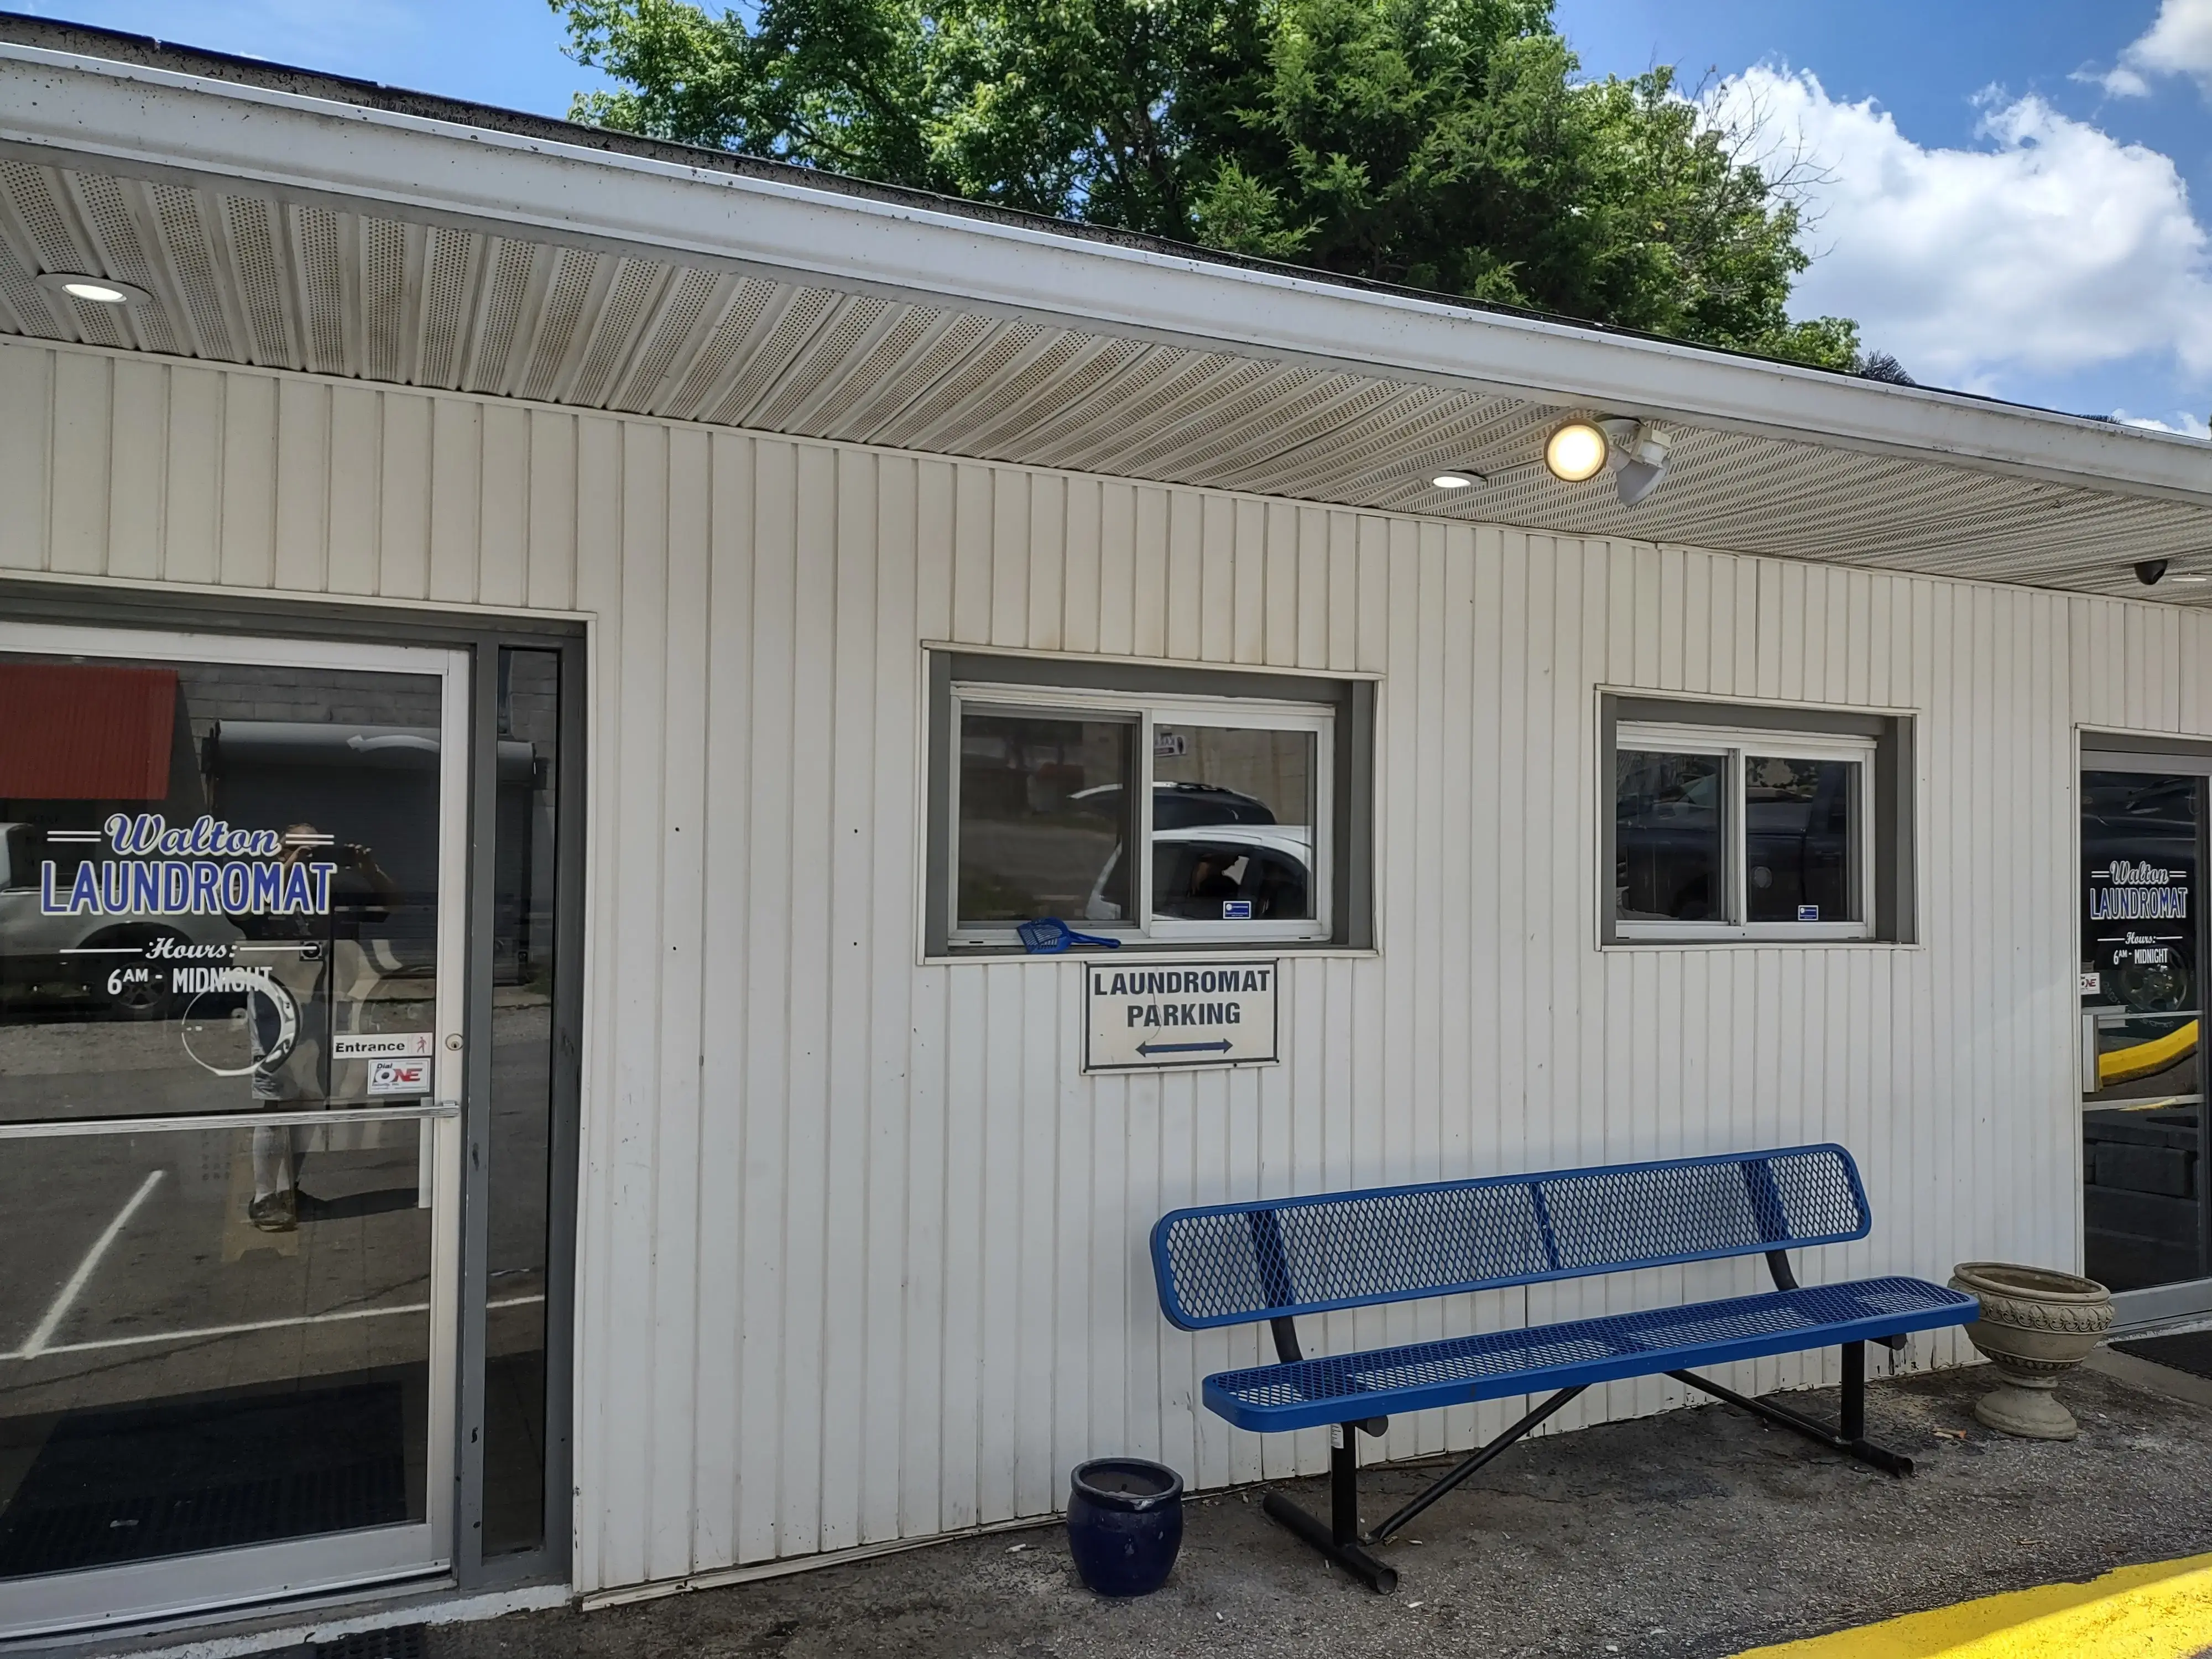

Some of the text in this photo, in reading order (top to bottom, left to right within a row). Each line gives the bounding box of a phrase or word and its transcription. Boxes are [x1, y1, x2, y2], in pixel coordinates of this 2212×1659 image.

[105, 813, 282, 856] Walton
[2110, 860, 2169, 885] Walton
[41, 860, 337, 916] LAUNDROMAT
[2090, 888, 2188, 920] LAUNDROMAT
[145, 937, 238, 959] Hours:
[2125, 932, 2156, 944] Hours:
[2134, 948, 2168, 964] MIDNIGHT
[107, 968, 149, 995] 6AM
[173, 967, 273, 993] MIDNIGHT
[1094, 970, 1270, 995] LAUNDROMAT
[1128, 1002, 1240, 1027] PARKING
[336, 1042, 405, 1052] Entrance
[374, 1068, 422, 1082] ONE
